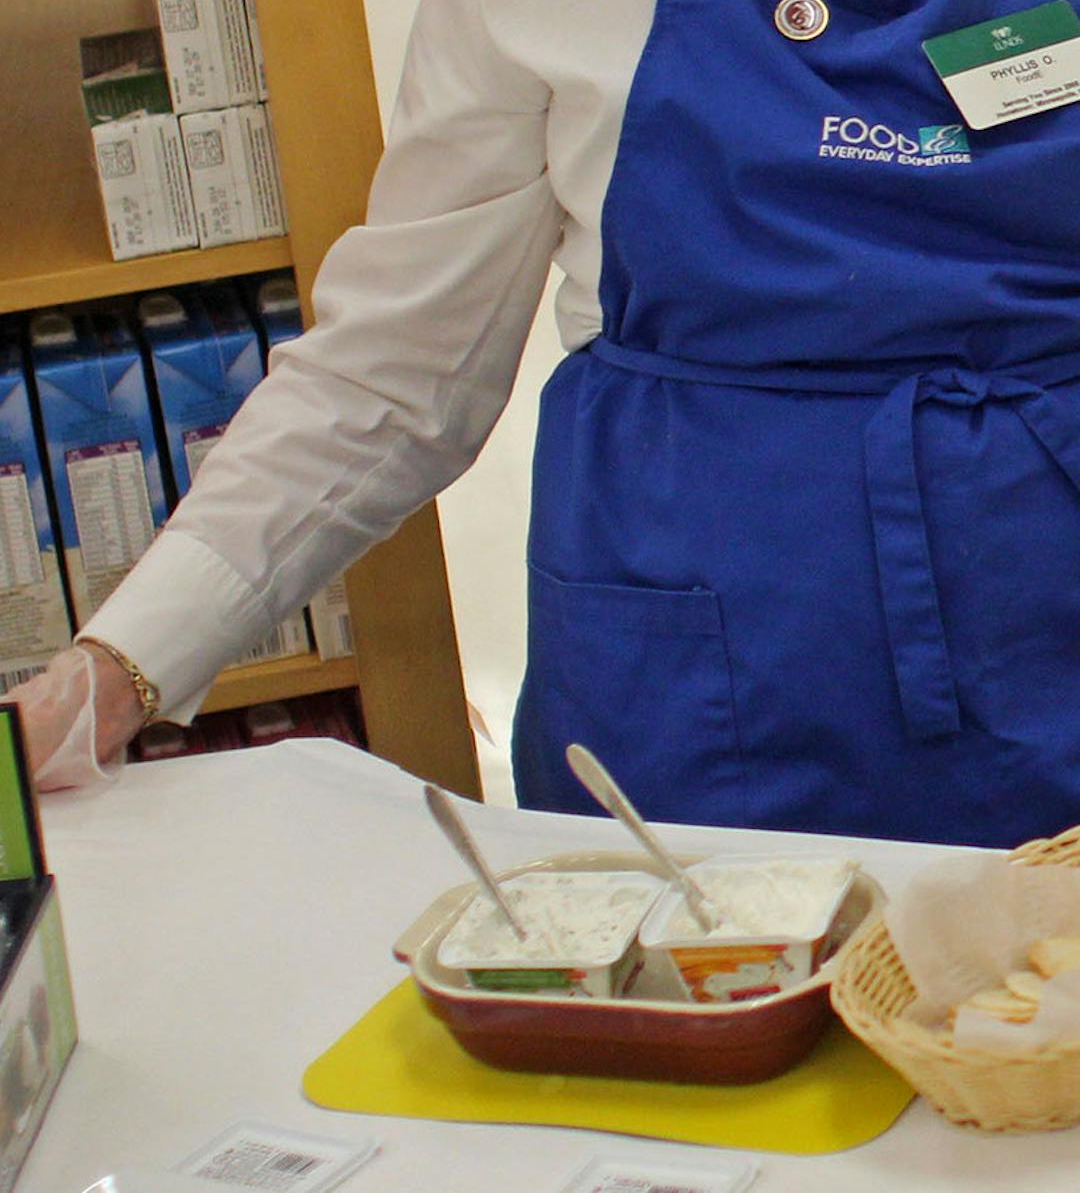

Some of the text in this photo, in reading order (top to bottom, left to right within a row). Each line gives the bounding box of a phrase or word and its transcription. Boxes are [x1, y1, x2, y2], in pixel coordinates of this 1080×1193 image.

[990, 61, 1039, 81] PHYLLIS
[1044, 85, 1063, 97] Since
[819, 144, 972, 166] EVERYDAY EXPERTISE
